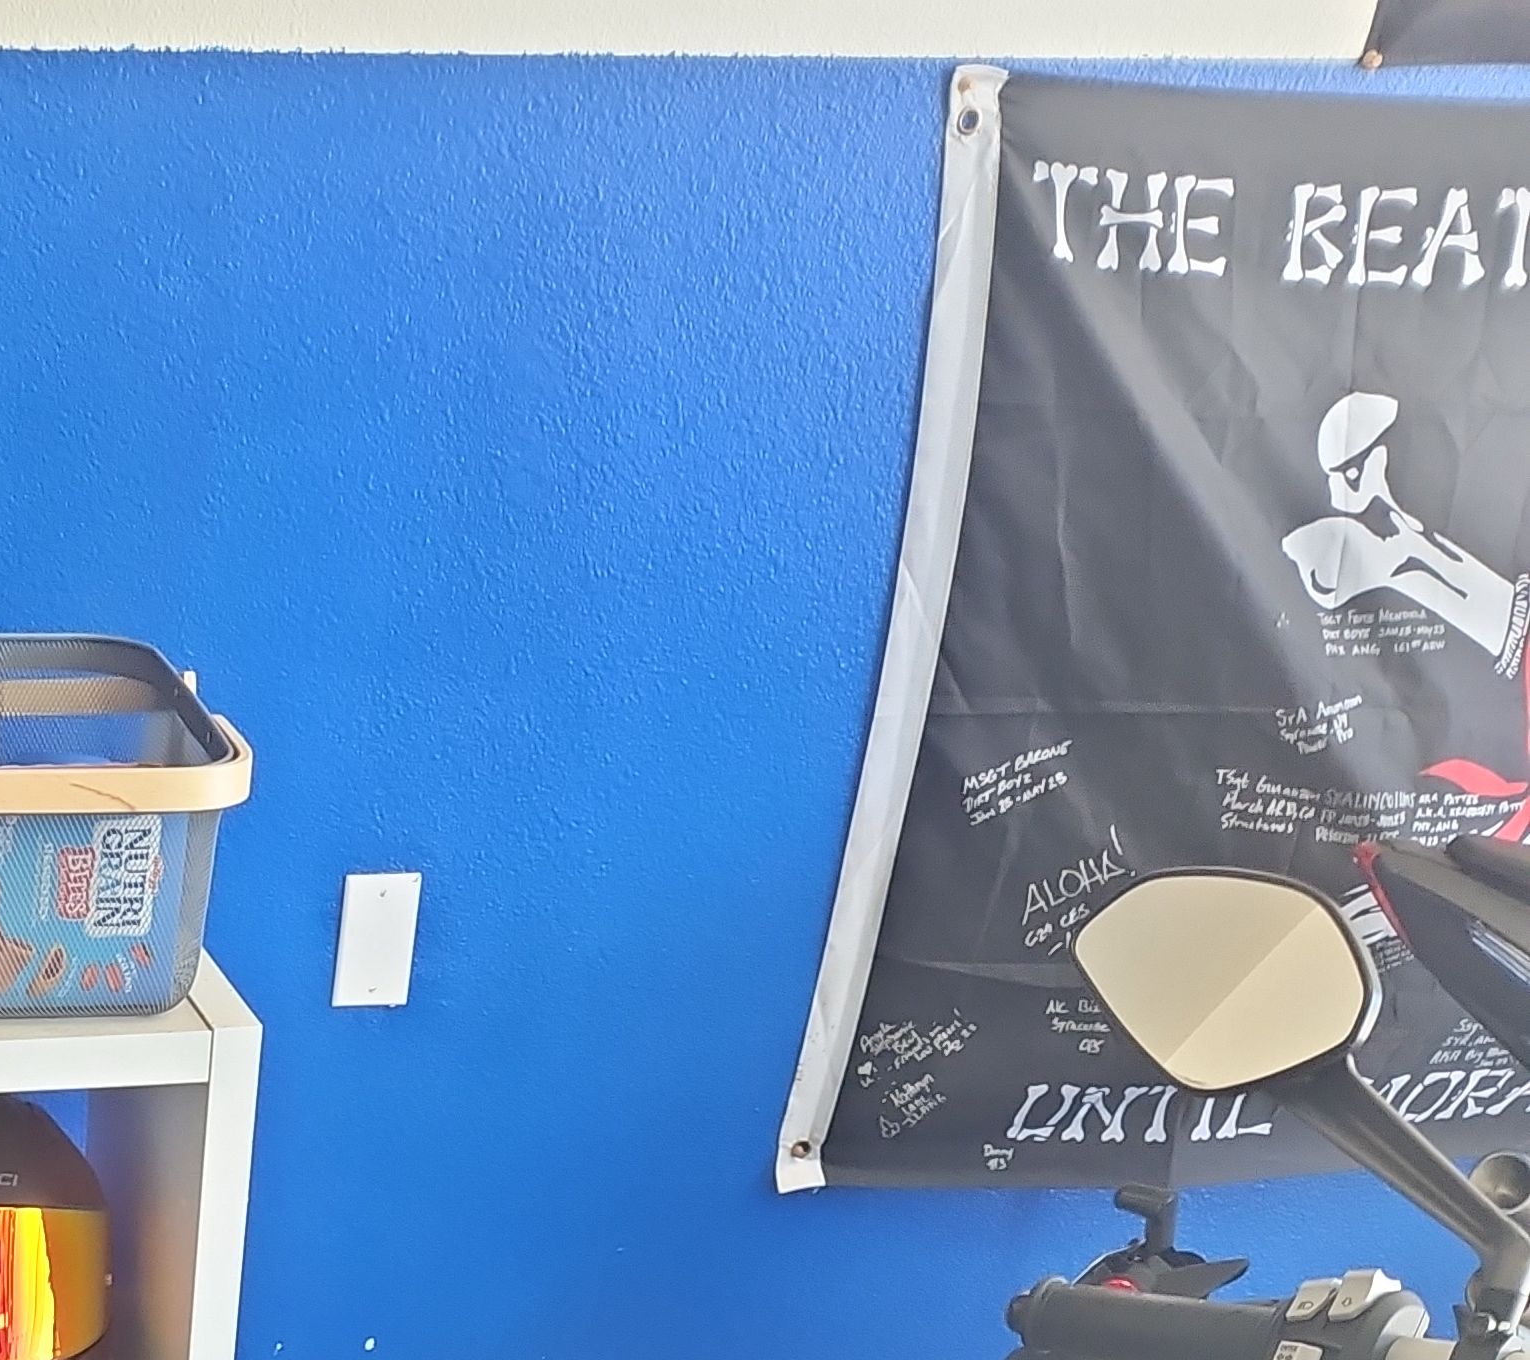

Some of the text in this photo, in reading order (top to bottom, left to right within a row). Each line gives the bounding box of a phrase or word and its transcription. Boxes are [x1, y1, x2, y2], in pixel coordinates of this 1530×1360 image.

[1033, 159, 1235, 277] THE
[962, 760, 1012, 796] MSGT
[93, 826, 126, 928] GRAIN
[123, 827, 152, 928] NUTRI
[1022, 823, 1137, 926] ALOHA!
[1006, 1083, 1273, 1143] UNTIL
